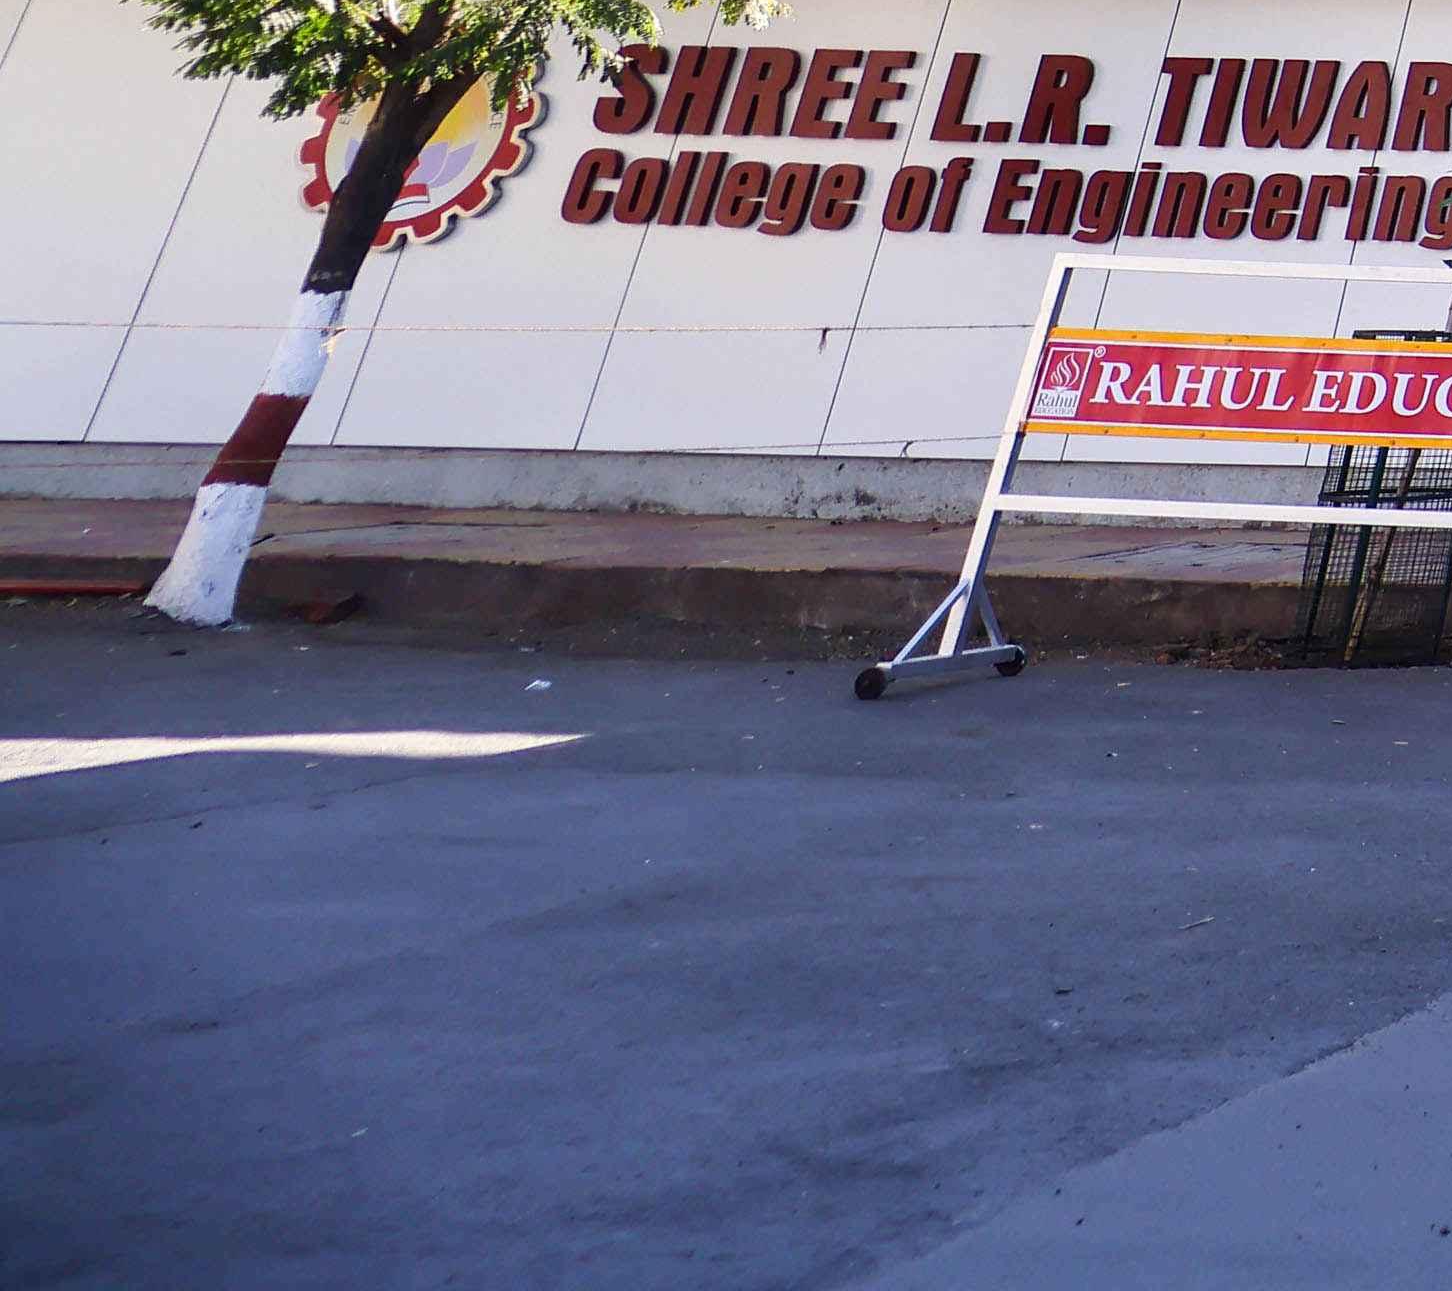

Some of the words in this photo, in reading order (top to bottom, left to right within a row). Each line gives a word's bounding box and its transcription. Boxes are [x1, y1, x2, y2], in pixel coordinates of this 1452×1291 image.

[592, 43, 917, 141] SHREE
[560, 147, 866, 236] College
[881, 156, 974, 233] of
[1037, 392, 1078, 408] Rahul
[1088, 361, 1296, 412] RAHUL
